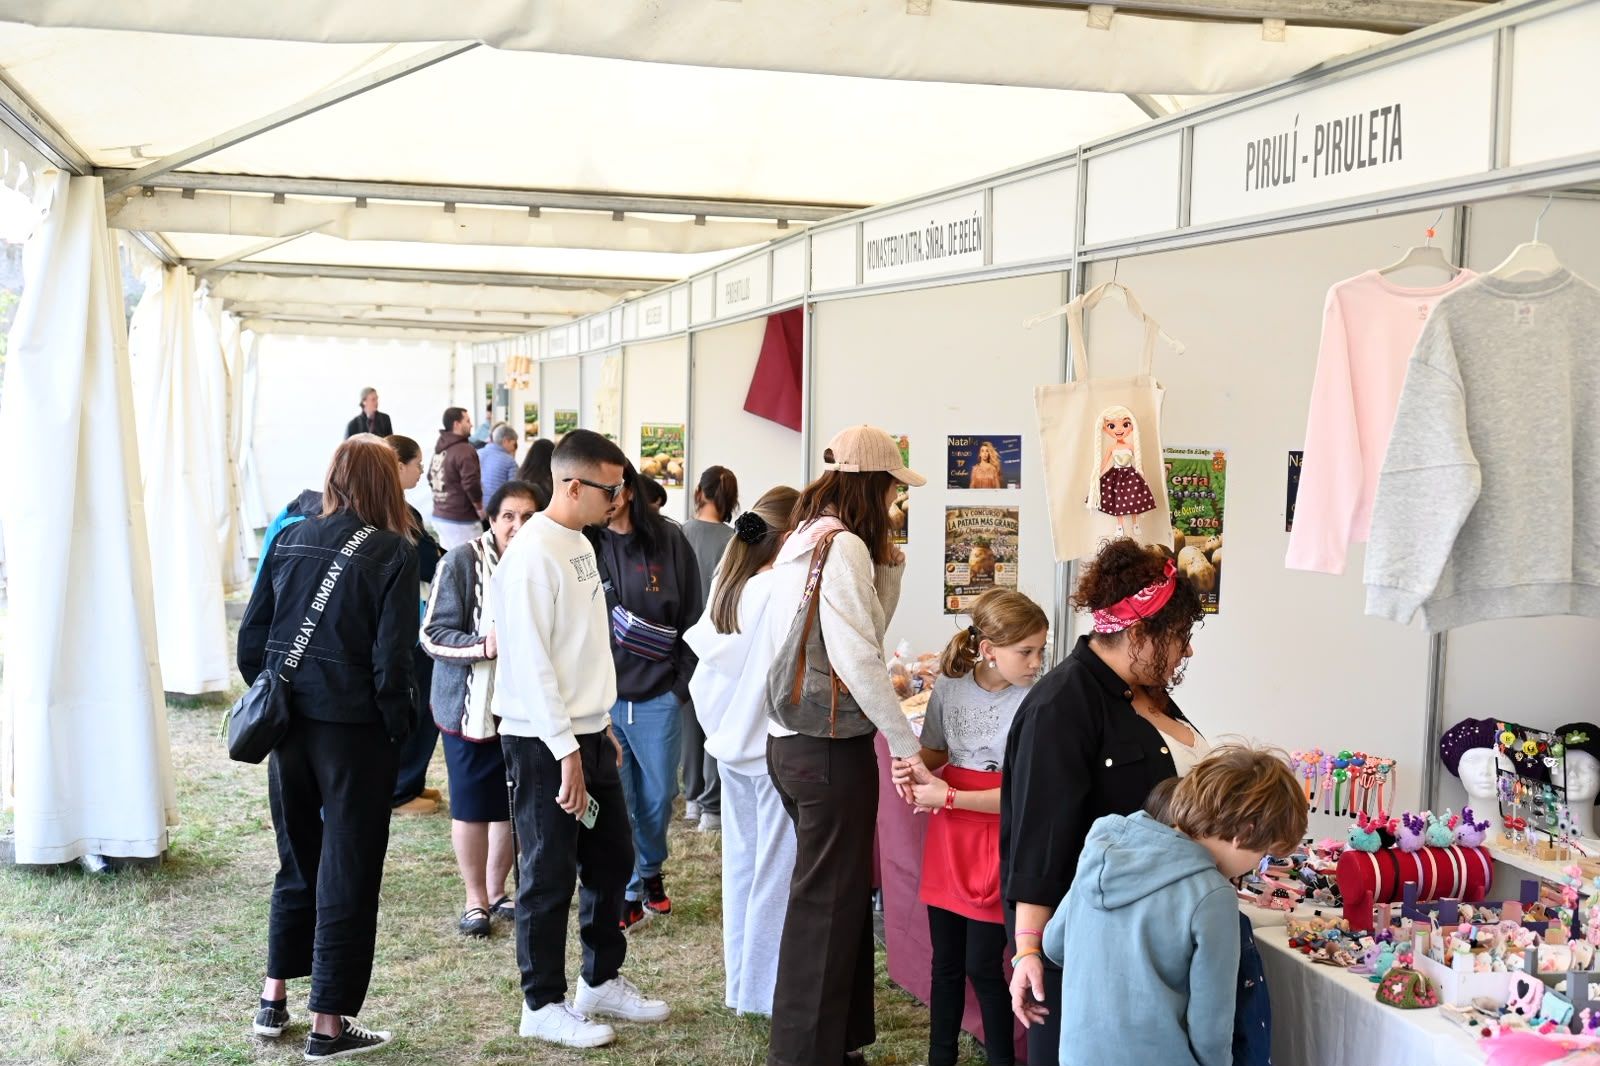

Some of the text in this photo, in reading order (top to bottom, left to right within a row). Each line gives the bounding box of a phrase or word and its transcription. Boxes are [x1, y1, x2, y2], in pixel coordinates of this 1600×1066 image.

[1246, 103, 1402, 192] PIRULÍ - PIRULETA
[948, 222, 957, 256] DE
[959, 210, 982, 254] BELÉN
[948, 517, 1018, 530] LA PATATA MÁS GRANDE
[1190, 518, 1219, 528] 2026
[284, 524, 378, 668] BIMBAY BIMBAY BIMBAY
